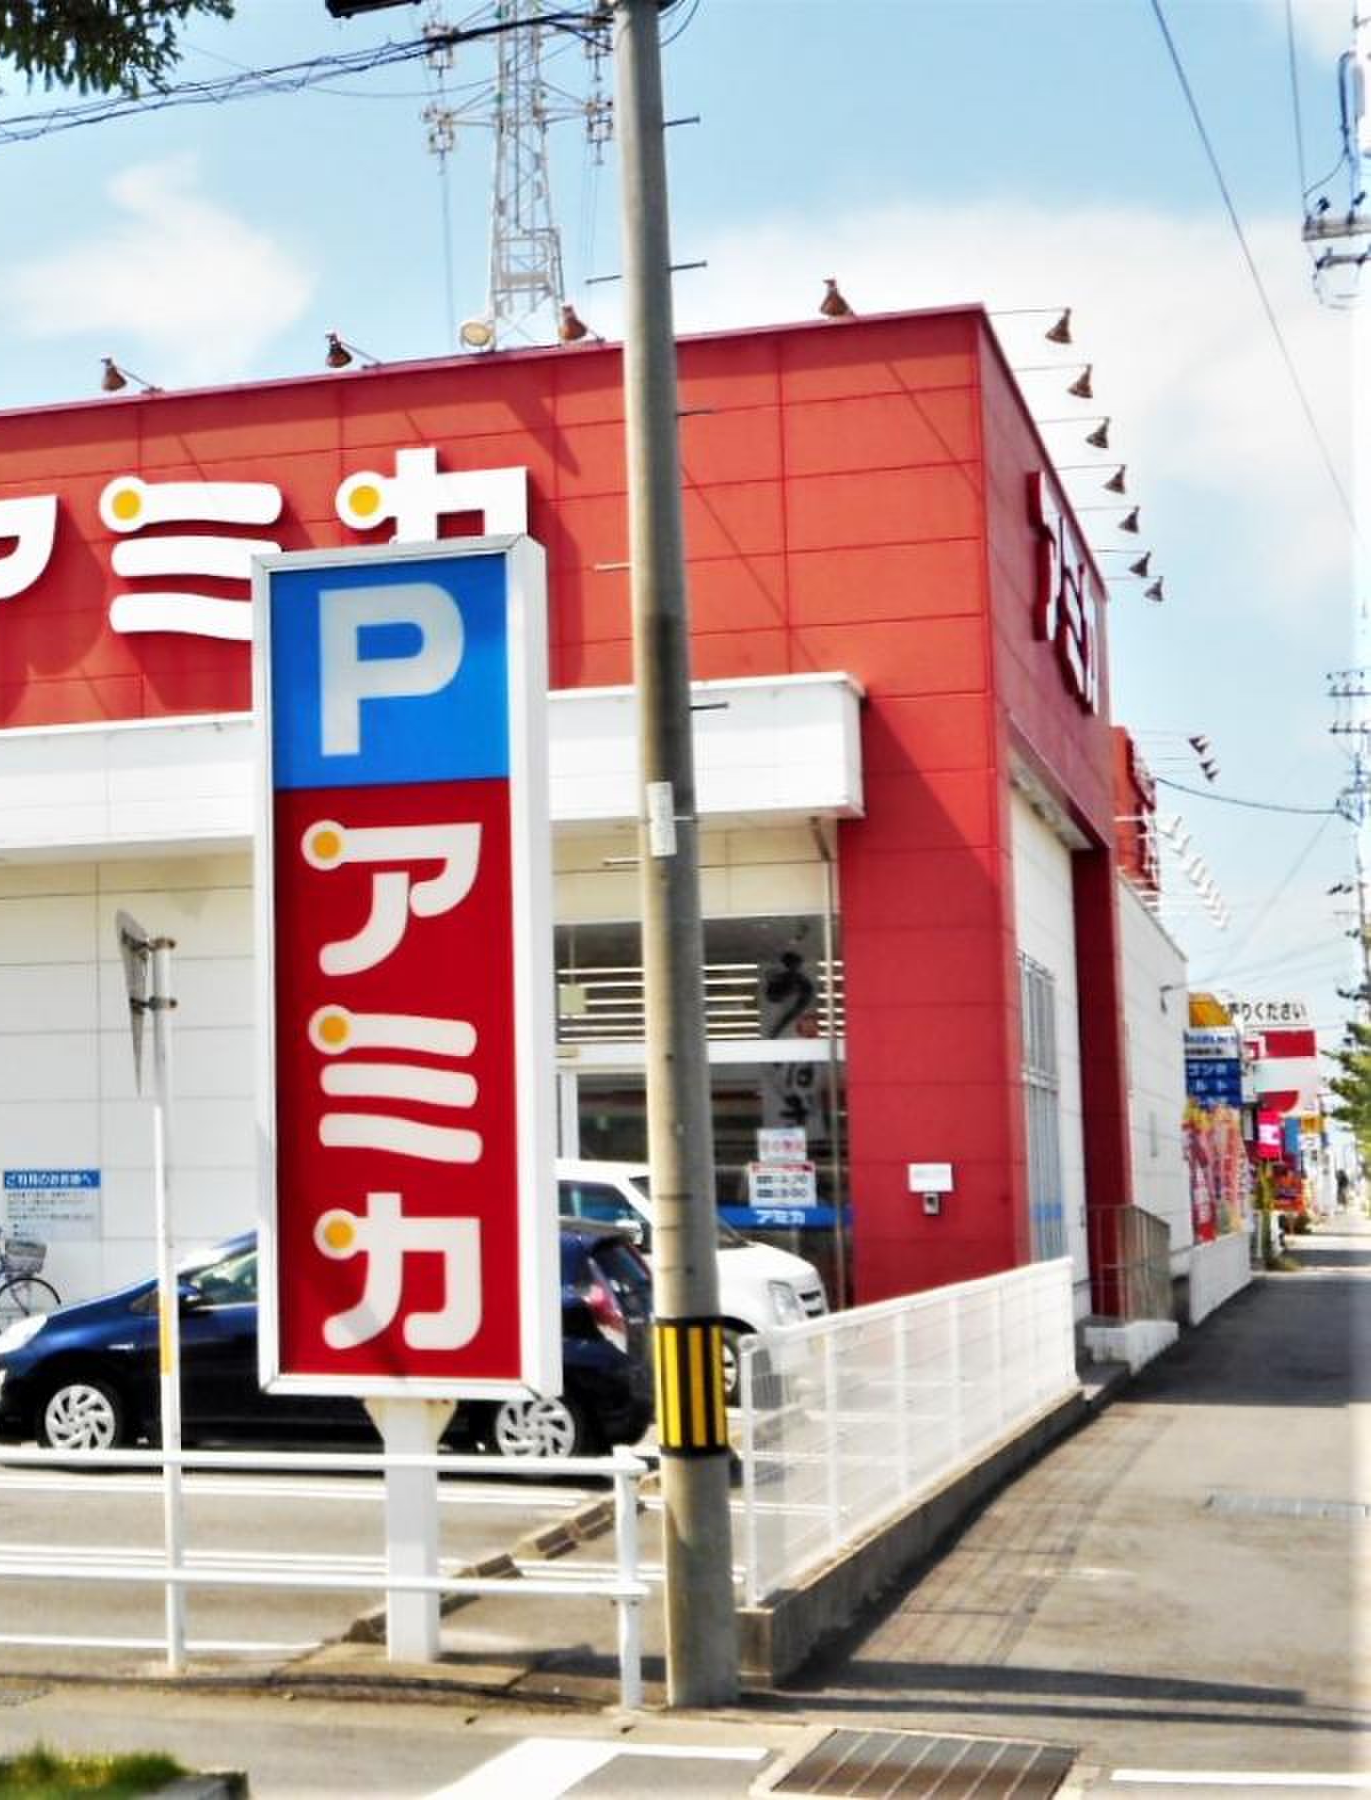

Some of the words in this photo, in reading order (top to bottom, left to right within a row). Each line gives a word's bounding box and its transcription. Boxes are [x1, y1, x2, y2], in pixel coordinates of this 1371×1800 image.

[318, 582, 465, 757] P
[300, 819, 484, 1353] アミカ
